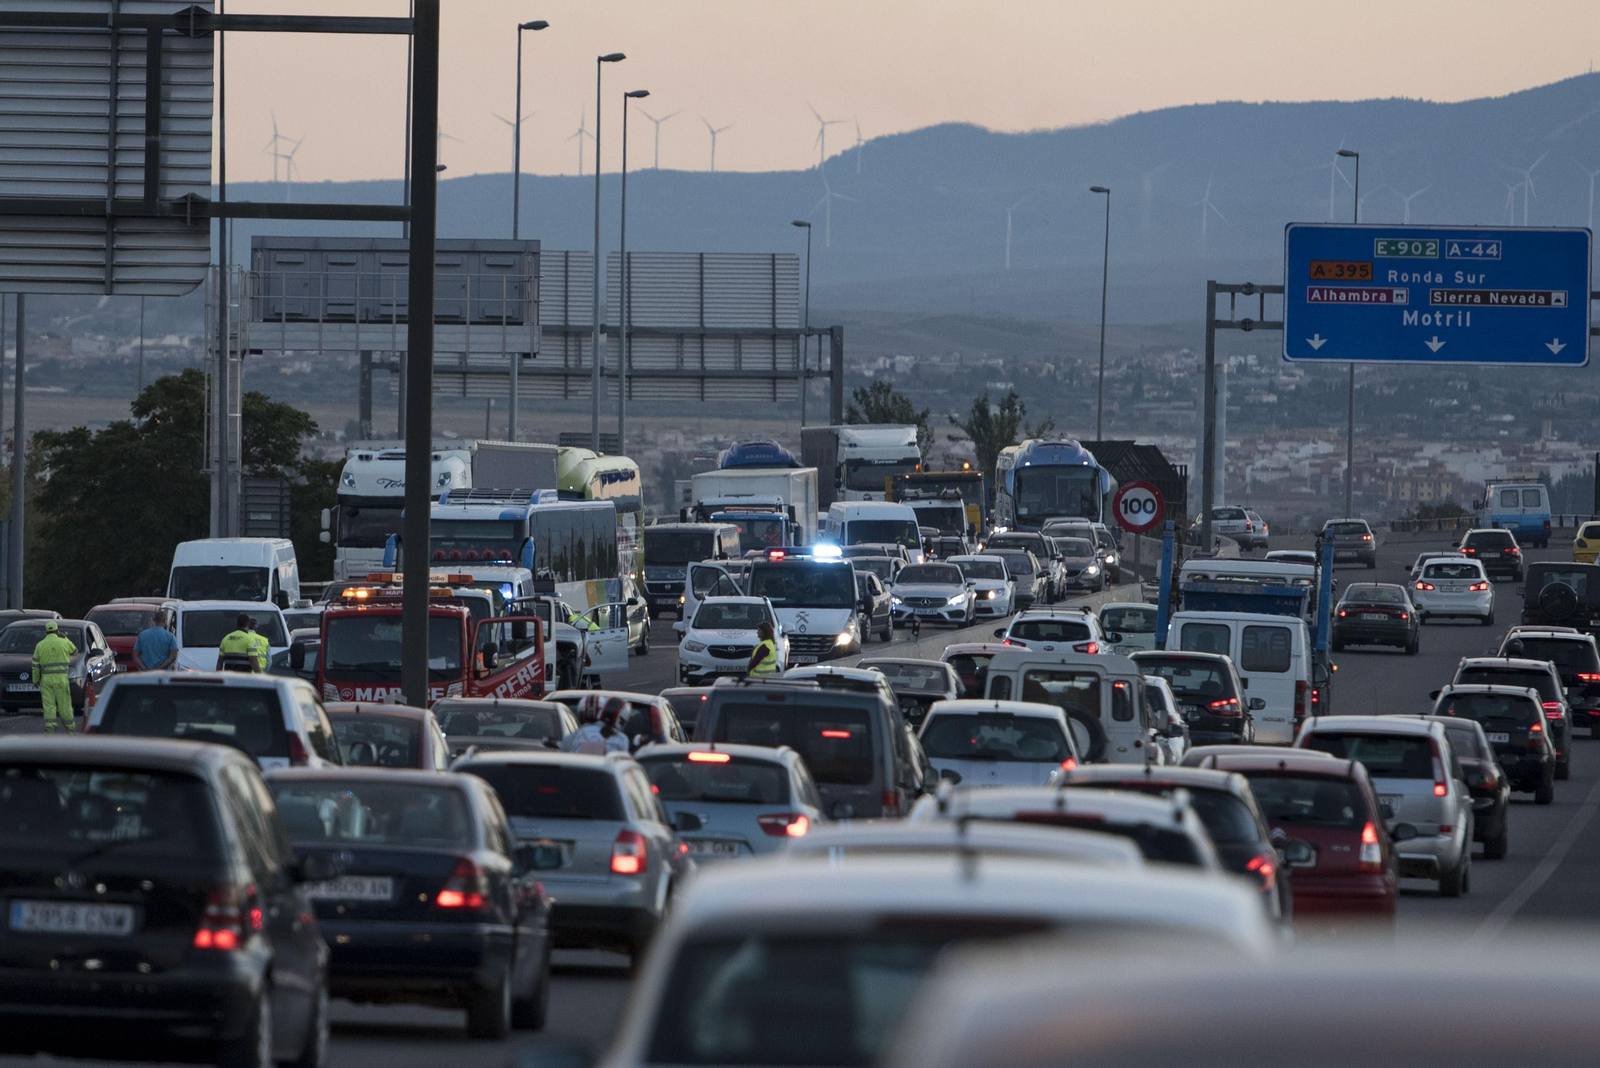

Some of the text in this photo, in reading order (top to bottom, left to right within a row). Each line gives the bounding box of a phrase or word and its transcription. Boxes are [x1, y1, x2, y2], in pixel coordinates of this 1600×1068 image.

[1376, 241, 1437, 256] E-902
[1449, 242, 1498, 257] A-44
[1313, 263, 1370, 278] A-395
[1387, 269, 1486, 284] Ronda Sur
[1310, 288, 1387, 302] Alhambra
[1433, 291, 1546, 305] Sierra Nevada
[1402, 309, 1471, 327] Motril
[1121, 498, 1157, 515] 100
